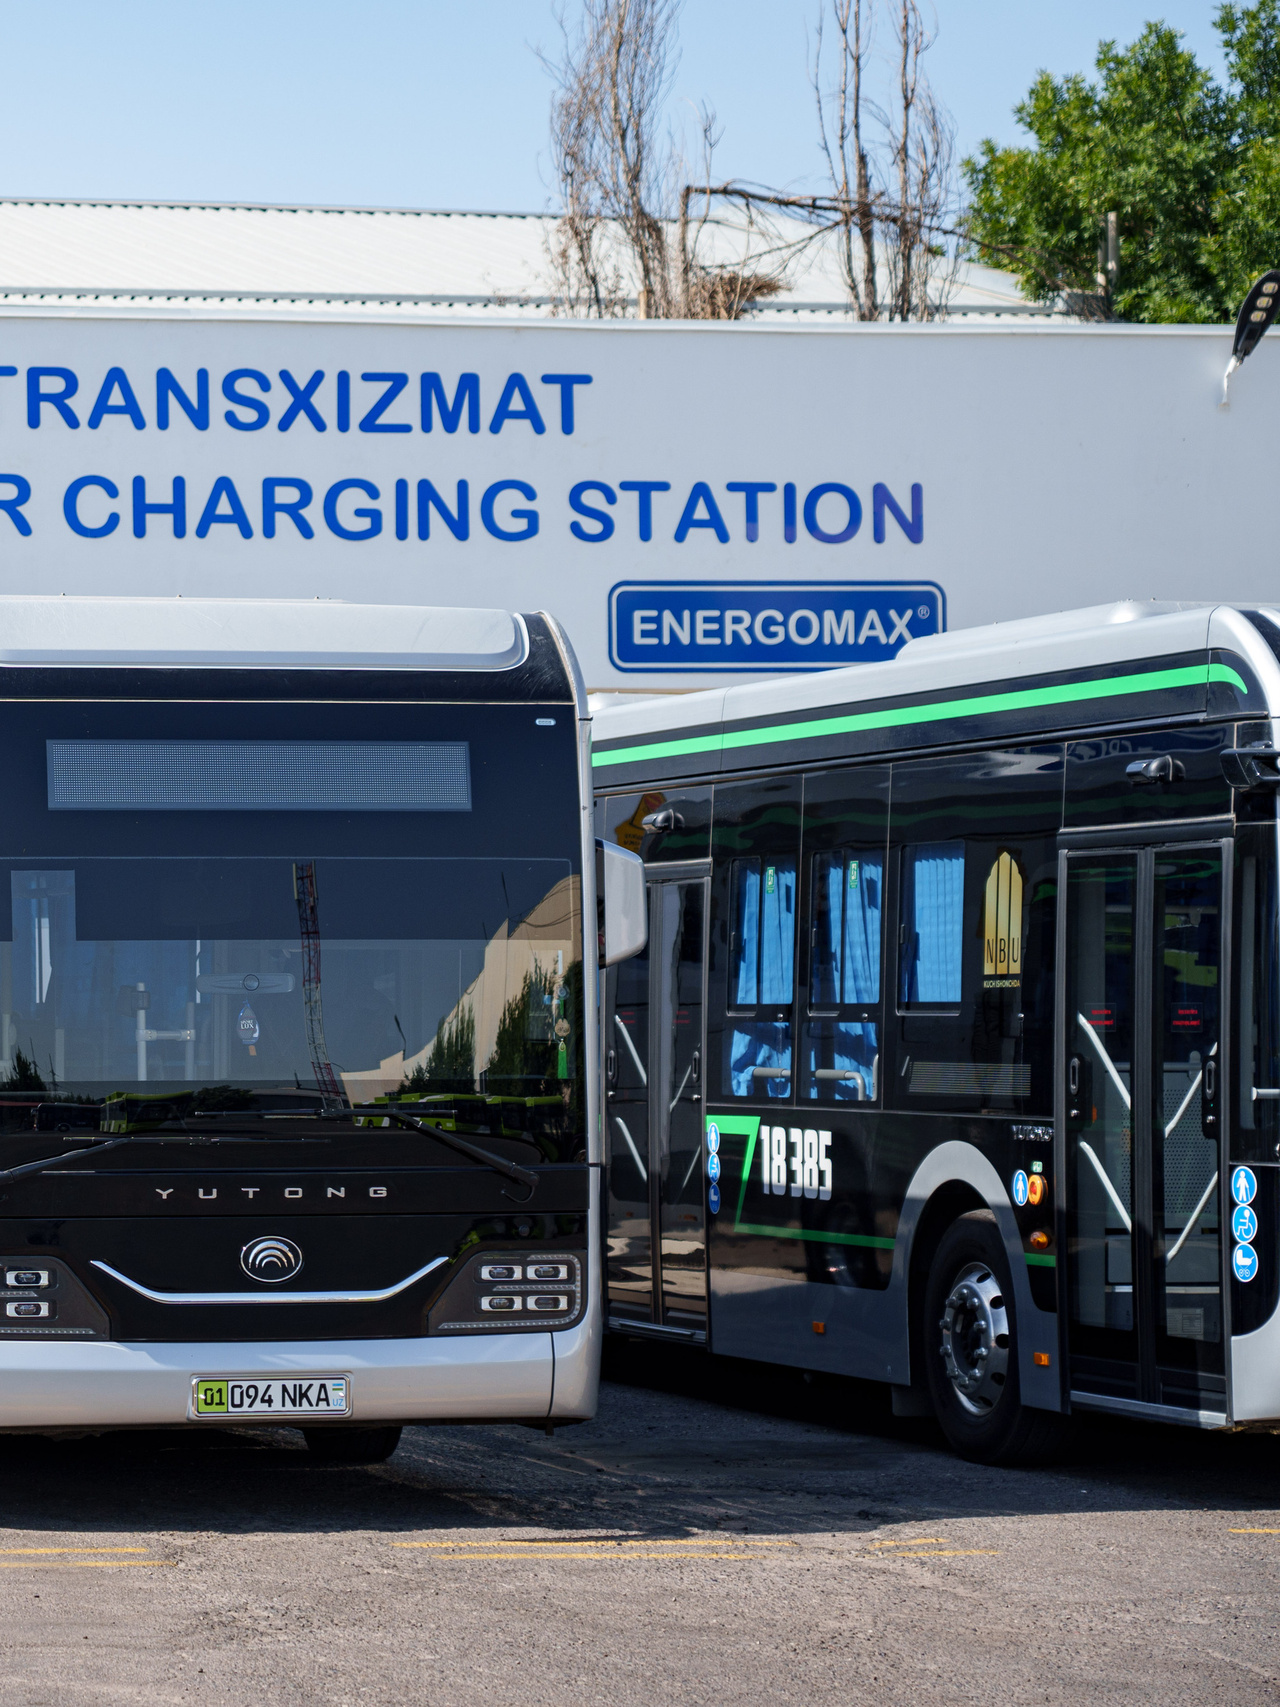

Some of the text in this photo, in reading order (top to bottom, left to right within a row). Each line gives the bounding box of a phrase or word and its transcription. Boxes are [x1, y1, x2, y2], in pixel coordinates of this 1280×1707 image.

[62, 474, 540, 543] CHARGING
[568, 480, 924, 544] STATION
[986, 937, 1020, 964] NBU
[760, 1124, 833, 1201] 18385
[155, 1186, 388, 1199] YUTONG
[203, 1383, 331, 1409] 01 094 NKA
[332, 1398, 344, 1407] UZ
